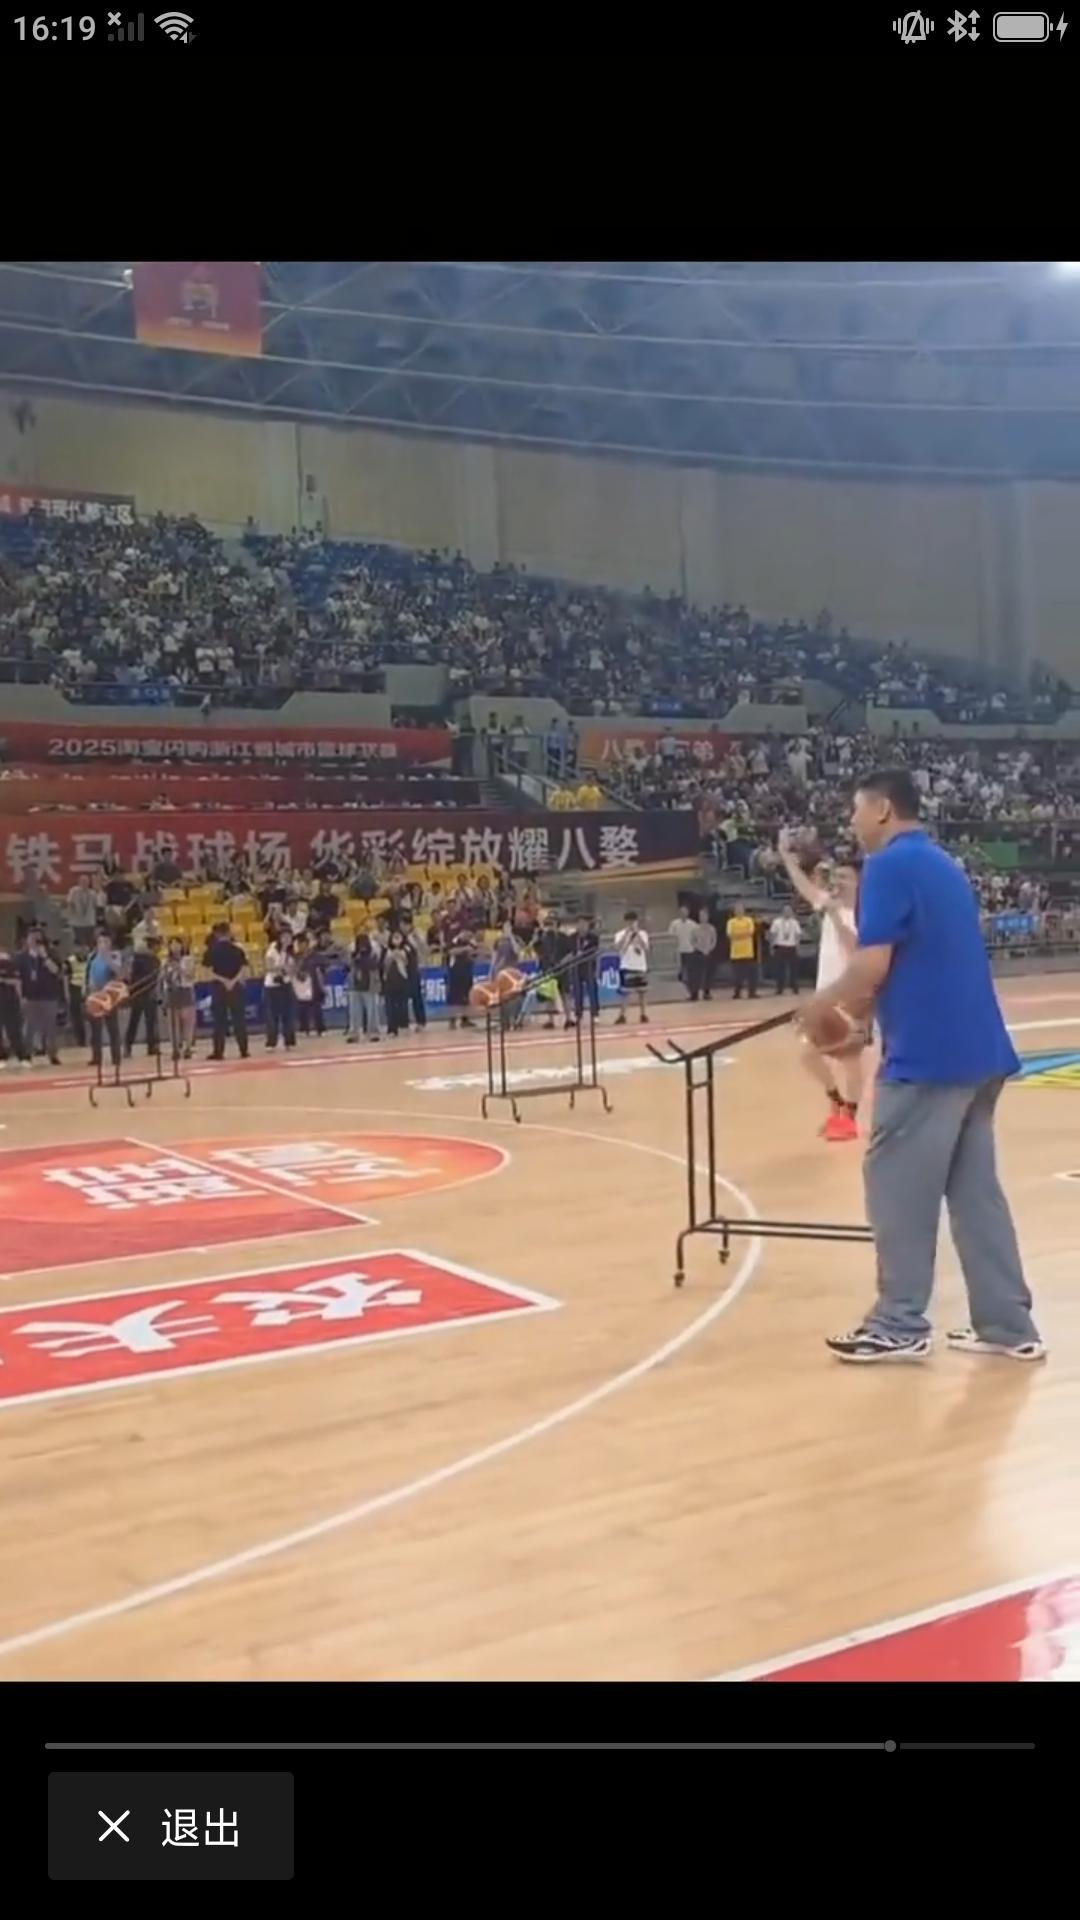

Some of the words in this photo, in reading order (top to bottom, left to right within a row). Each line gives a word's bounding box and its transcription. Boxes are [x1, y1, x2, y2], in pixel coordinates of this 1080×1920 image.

[5, 830, 292, 880] 铁马战球场
[12, 1271, 423, 1358] 农夫
